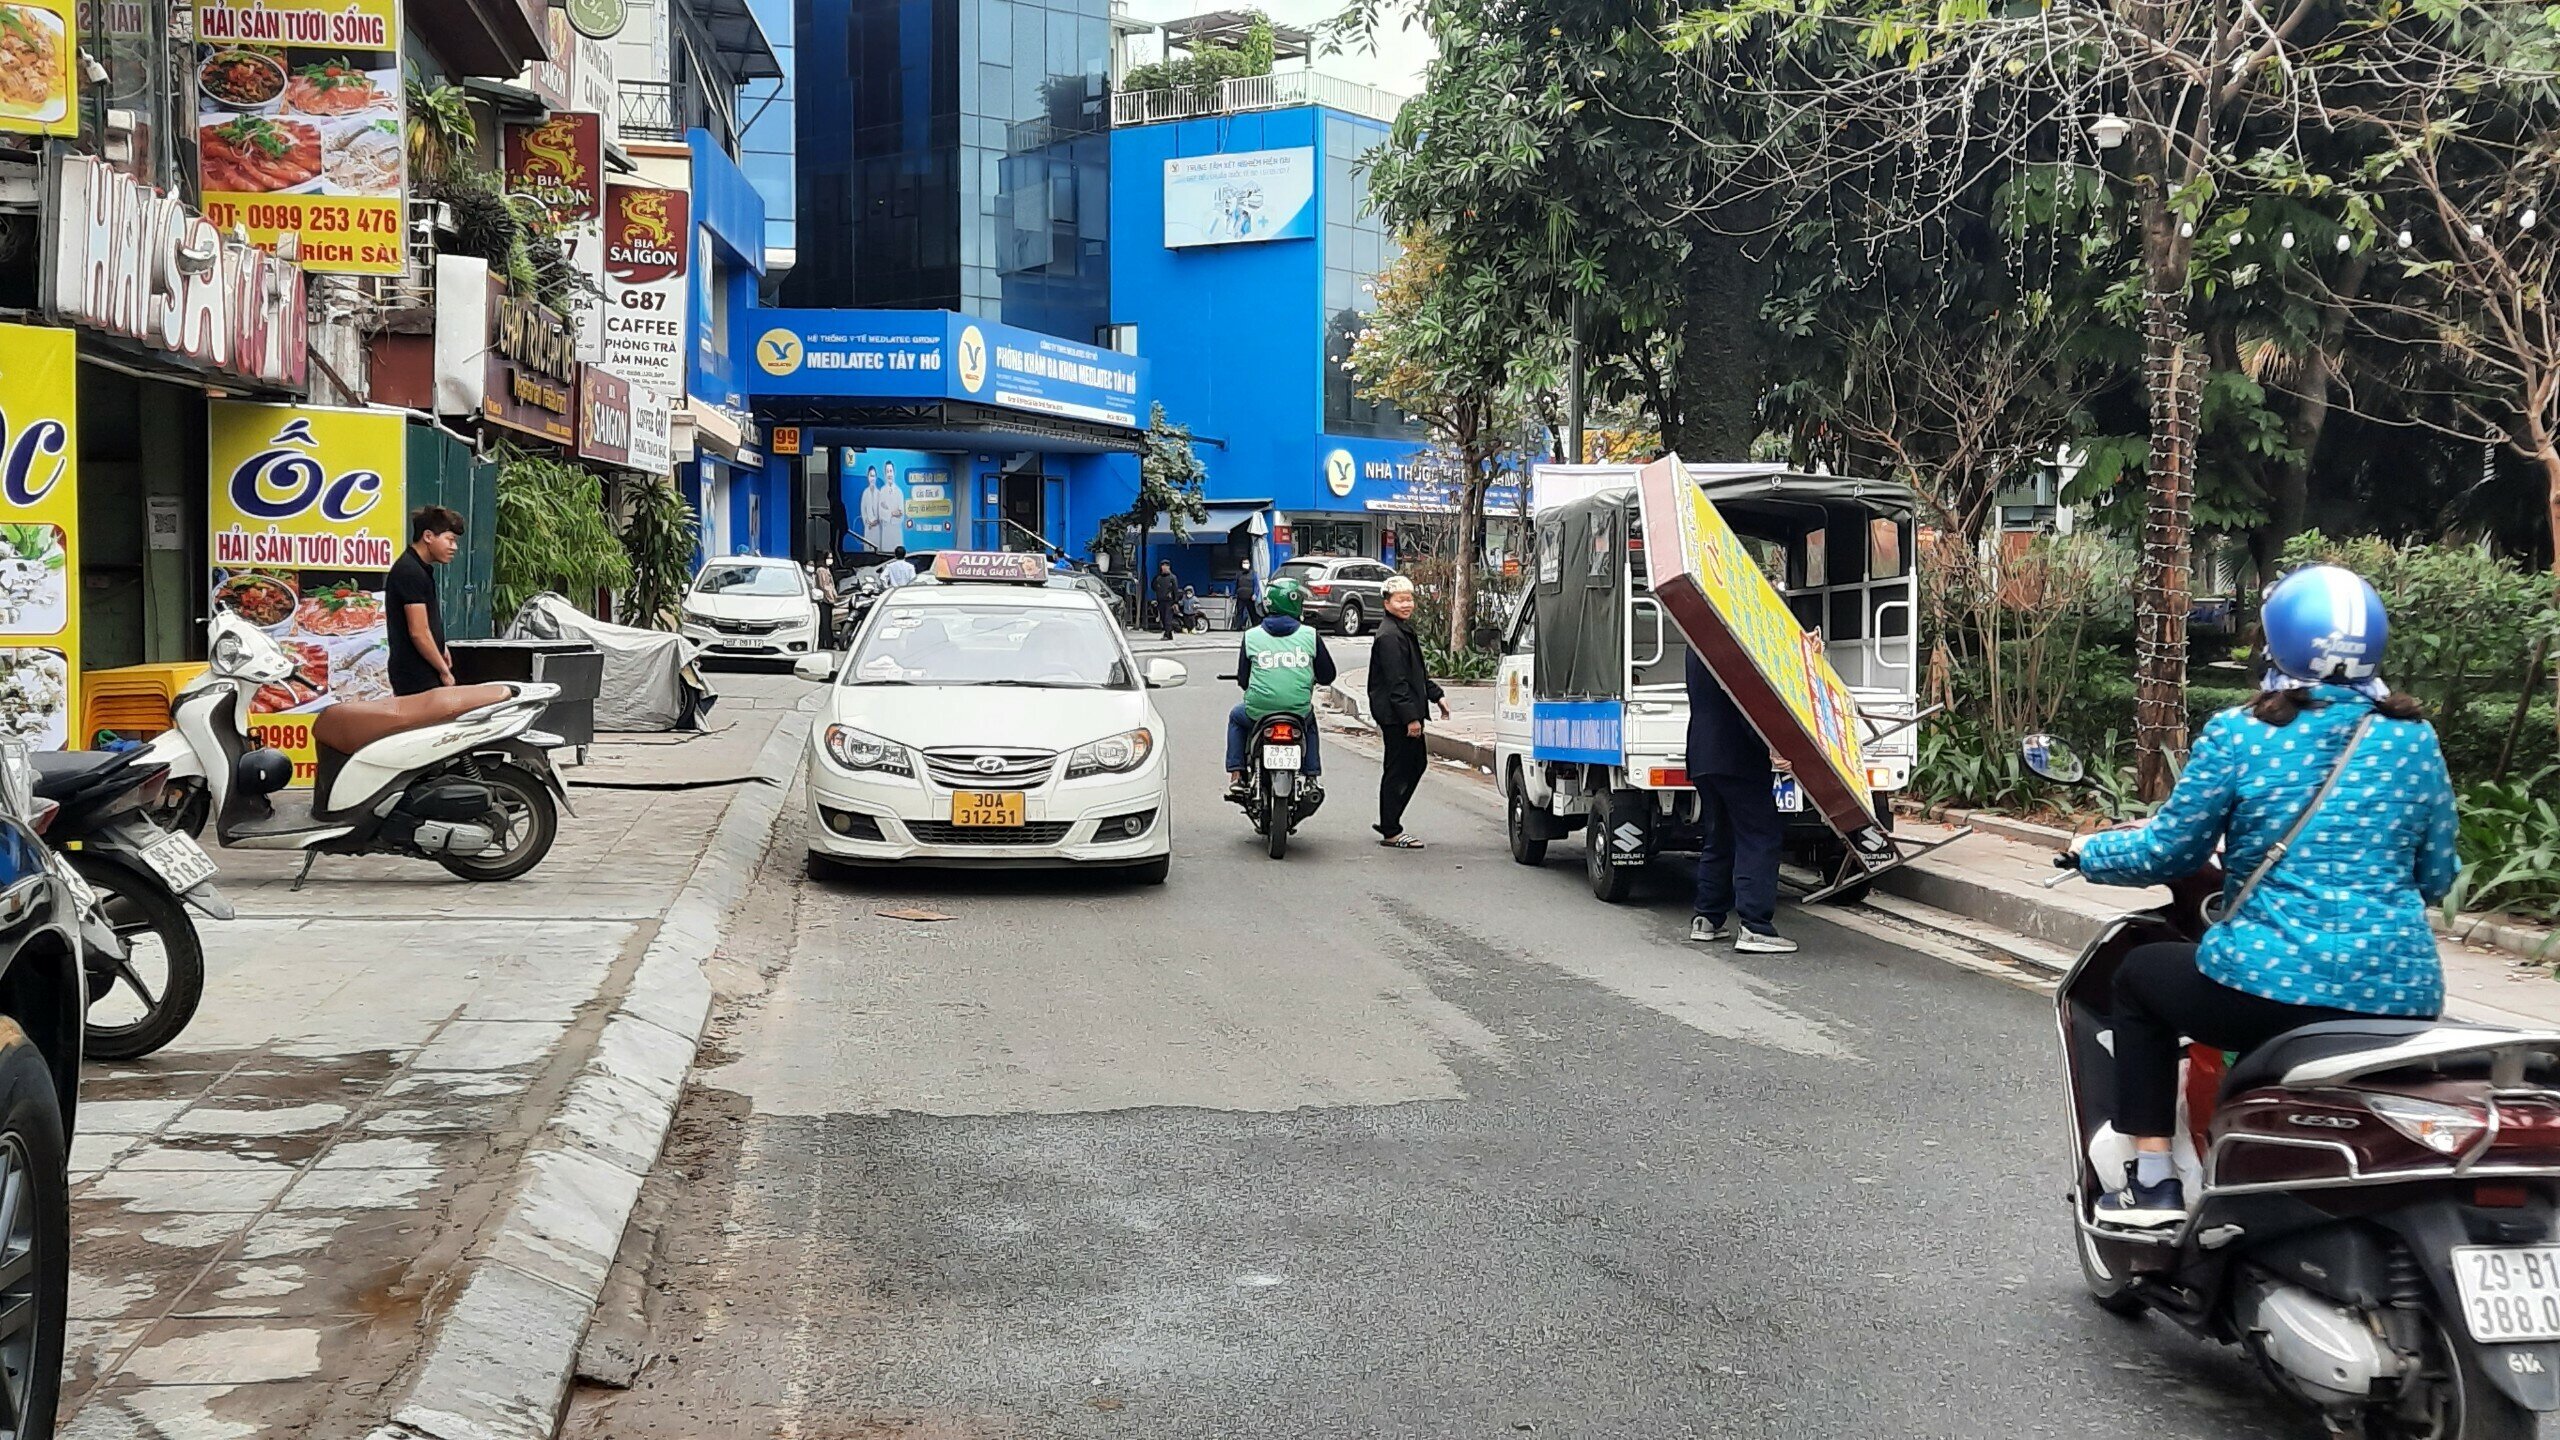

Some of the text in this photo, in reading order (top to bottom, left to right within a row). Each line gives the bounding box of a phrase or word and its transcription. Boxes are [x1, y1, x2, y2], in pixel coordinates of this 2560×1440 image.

[202, 0, 384, 44] HẢI SẢN TƯƠI SỐNG
[249, 204, 302, 230] 0989
[310, 207, 349, 232] 253
[357, 209, 396, 234] 476
[303, 241, 354, 262] RÍCH
[634, 239, 654, 249] BIA
[610, 247, 678, 265] SAIGON
[621, 290, 667, 311] G87
[607, 317, 678, 336] CAFFEE
[605, 337, 650, 351] PHÒNG
[653, 341, 677, 353] TRÀ
[634, 355, 669, 370] NHẠC
[807, 352, 884, 370] MEDLATEC
[888, 349, 917, 370] TÂY
[594, 401, 628, 449] SAIGON
[775, 429, 798, 445] 99
[229, 418, 382, 521] Ốc
[1365, 459, 1392, 479] NHÀ
[218, 525, 391, 566] HẢI SẢN TƯƠI SỐNG
[1258, 646, 1309, 668] Grab
[974, 794, 1004, 808] 30A
[961, 810, 1015, 825] 312.51
[2288, 1114, 2361, 1129] LEAD
[2474, 1295, 2560, 1335] 388.0
